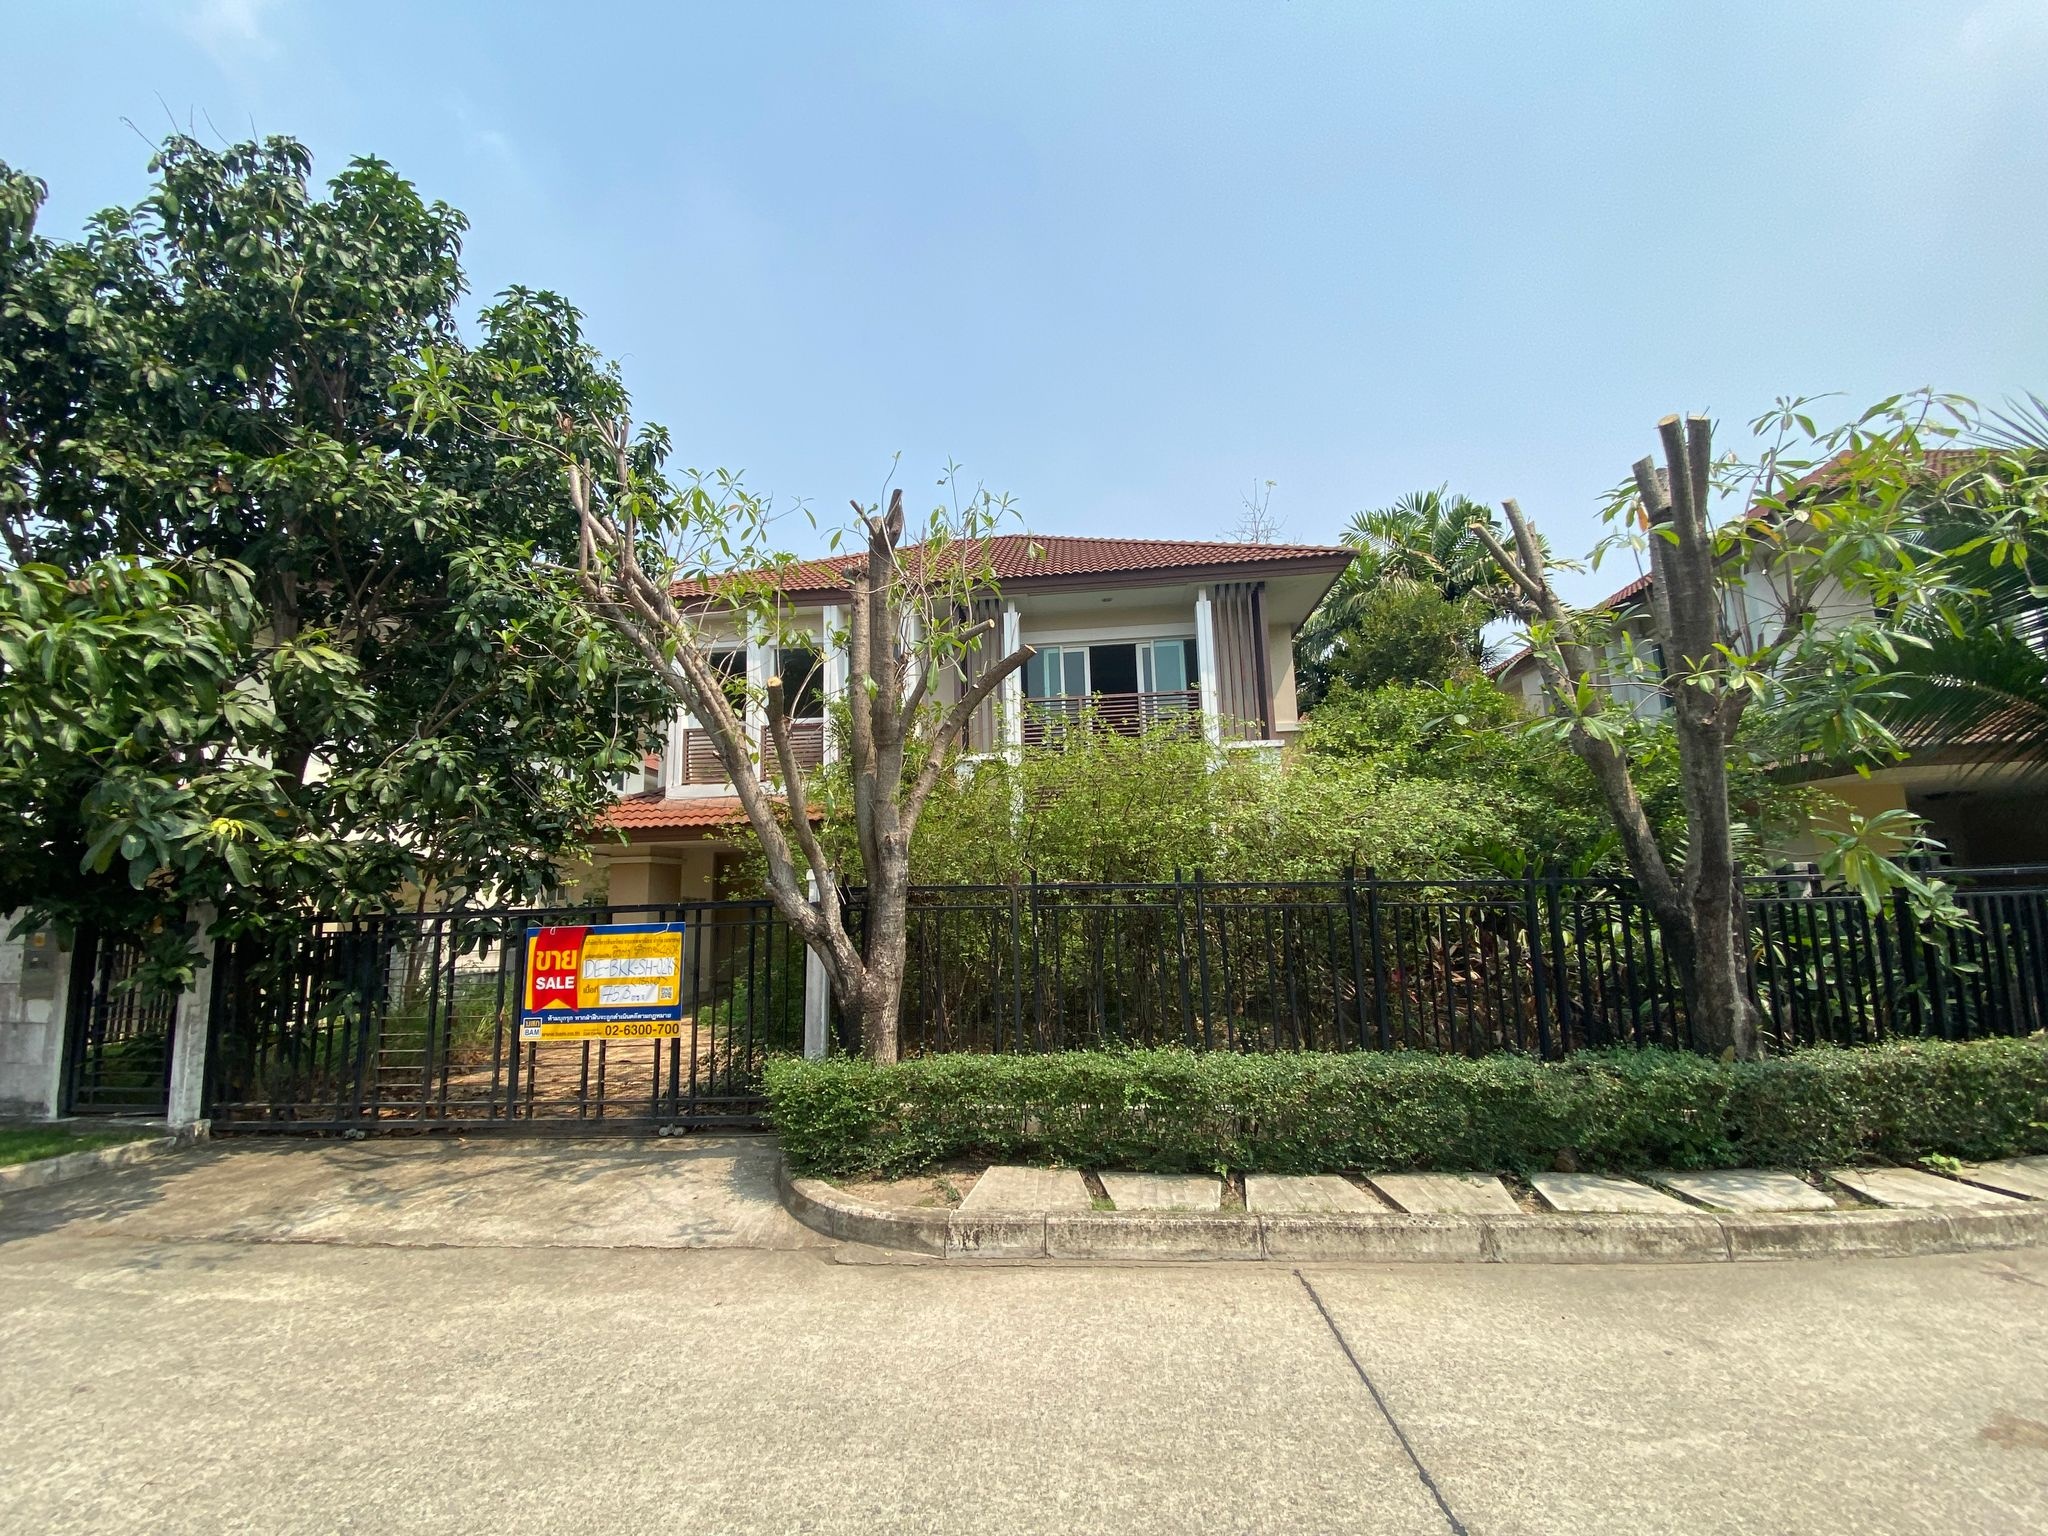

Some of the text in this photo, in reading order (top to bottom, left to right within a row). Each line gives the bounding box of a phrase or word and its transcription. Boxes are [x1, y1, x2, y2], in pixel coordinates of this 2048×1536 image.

[536, 949, 578, 971] ขาย
[536, 976, 575, 990] SALE
[605, 1023, 679, 1036] 02-6300-700
